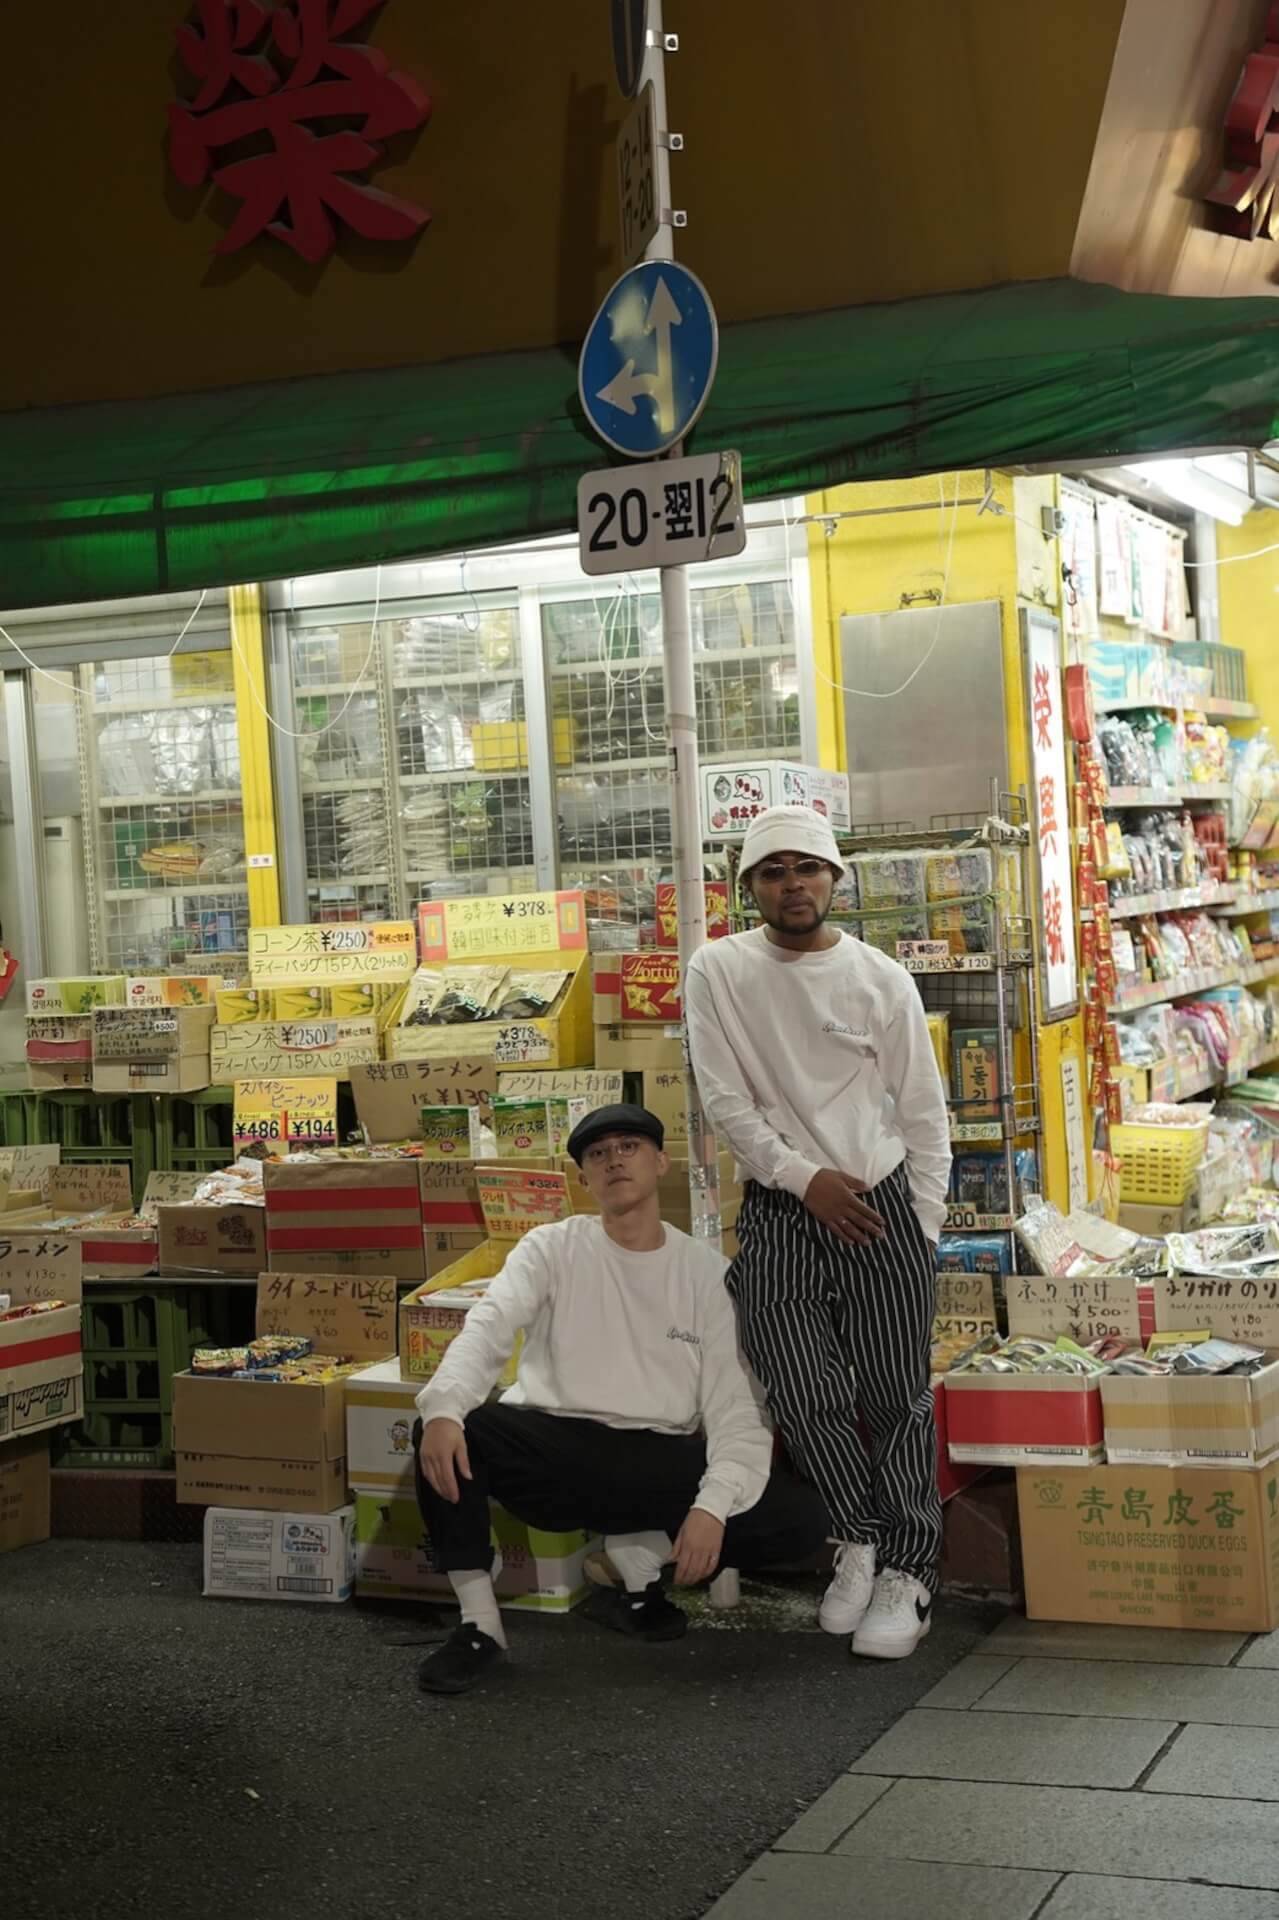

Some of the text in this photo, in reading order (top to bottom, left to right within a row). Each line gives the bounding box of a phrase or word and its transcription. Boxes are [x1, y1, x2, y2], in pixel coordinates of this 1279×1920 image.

[254, 929, 319, 953] コーン茶
[624, 955, 680, 978] Fortun
[213, 1023, 279, 1050] コーン茶
[239, 1081, 295, 1095] スパイシー
[235, 1120, 280, 1139] ¥486
[292, 1119, 335, 1138] ¥194
[1076, 1485, 1245, 1529] 青島皮蛋
[1077, 1529, 1247, 1551] TSINGTAO PRESERVED DUCK EGGS
